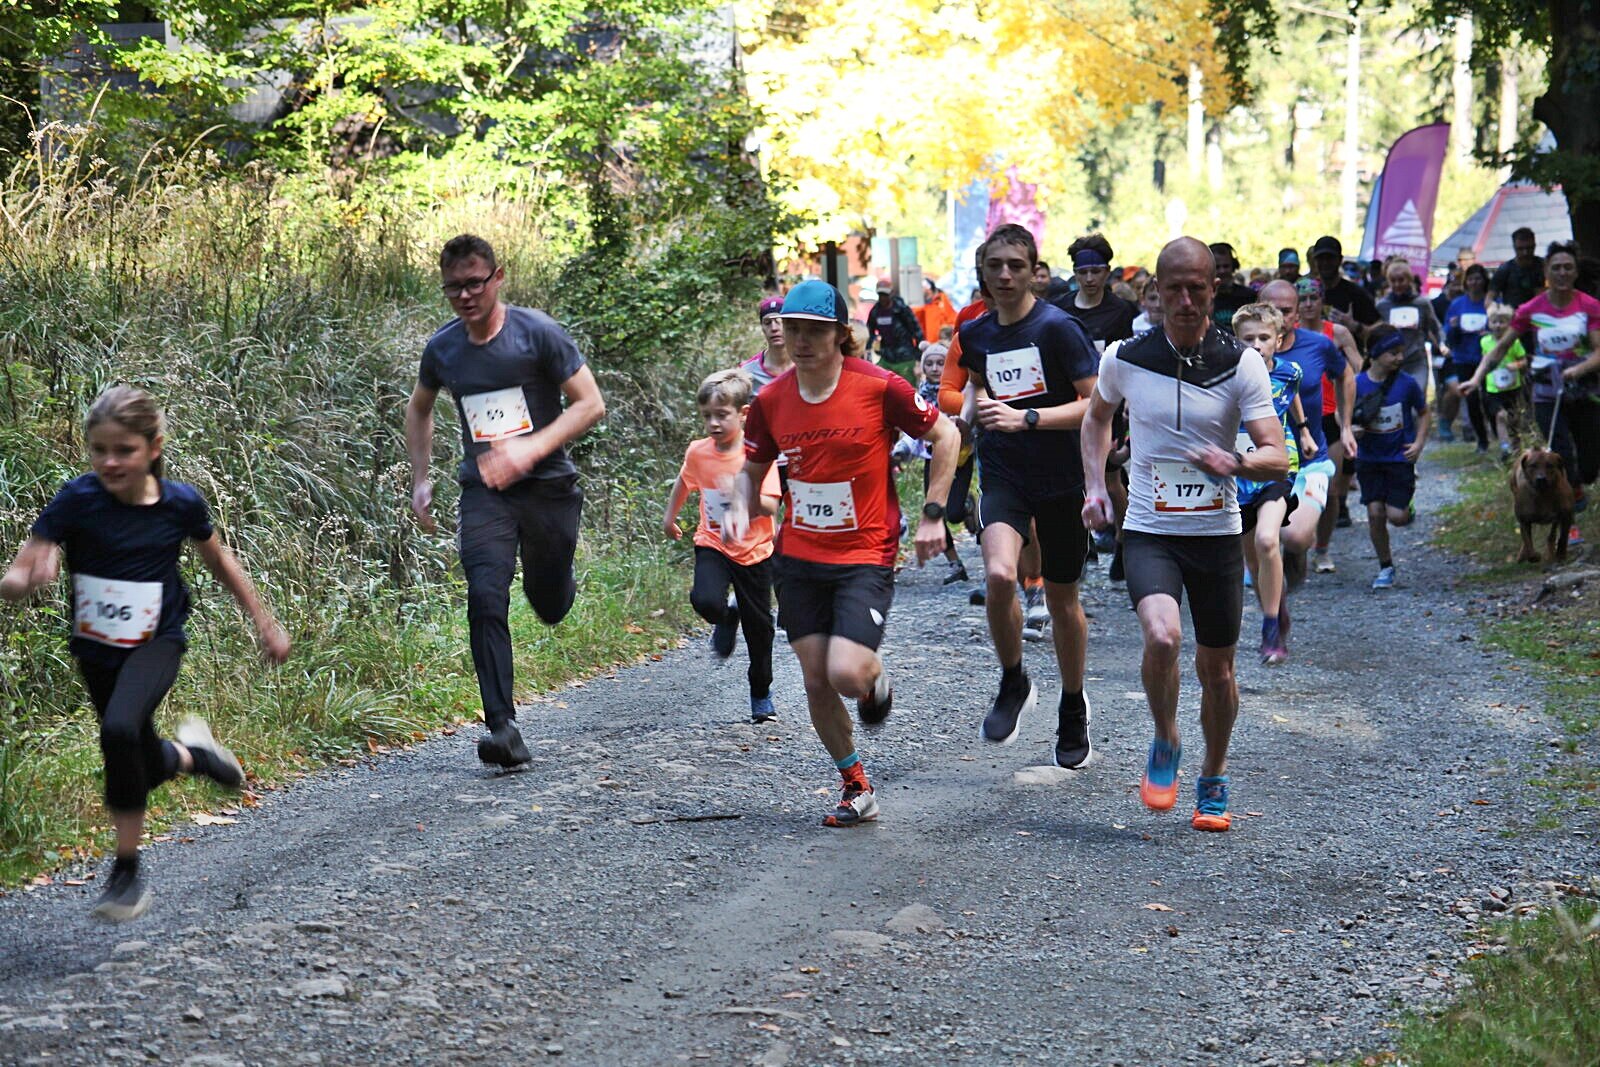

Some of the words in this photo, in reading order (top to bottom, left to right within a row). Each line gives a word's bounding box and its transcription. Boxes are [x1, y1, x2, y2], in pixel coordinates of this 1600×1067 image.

[996, 367, 1022, 383] 107
[780, 427, 863, 444] DYNAFIT
[1175, 484, 1205, 497] 177
[806, 503, 833, 517] 178
[95, 601, 133, 621] 106
